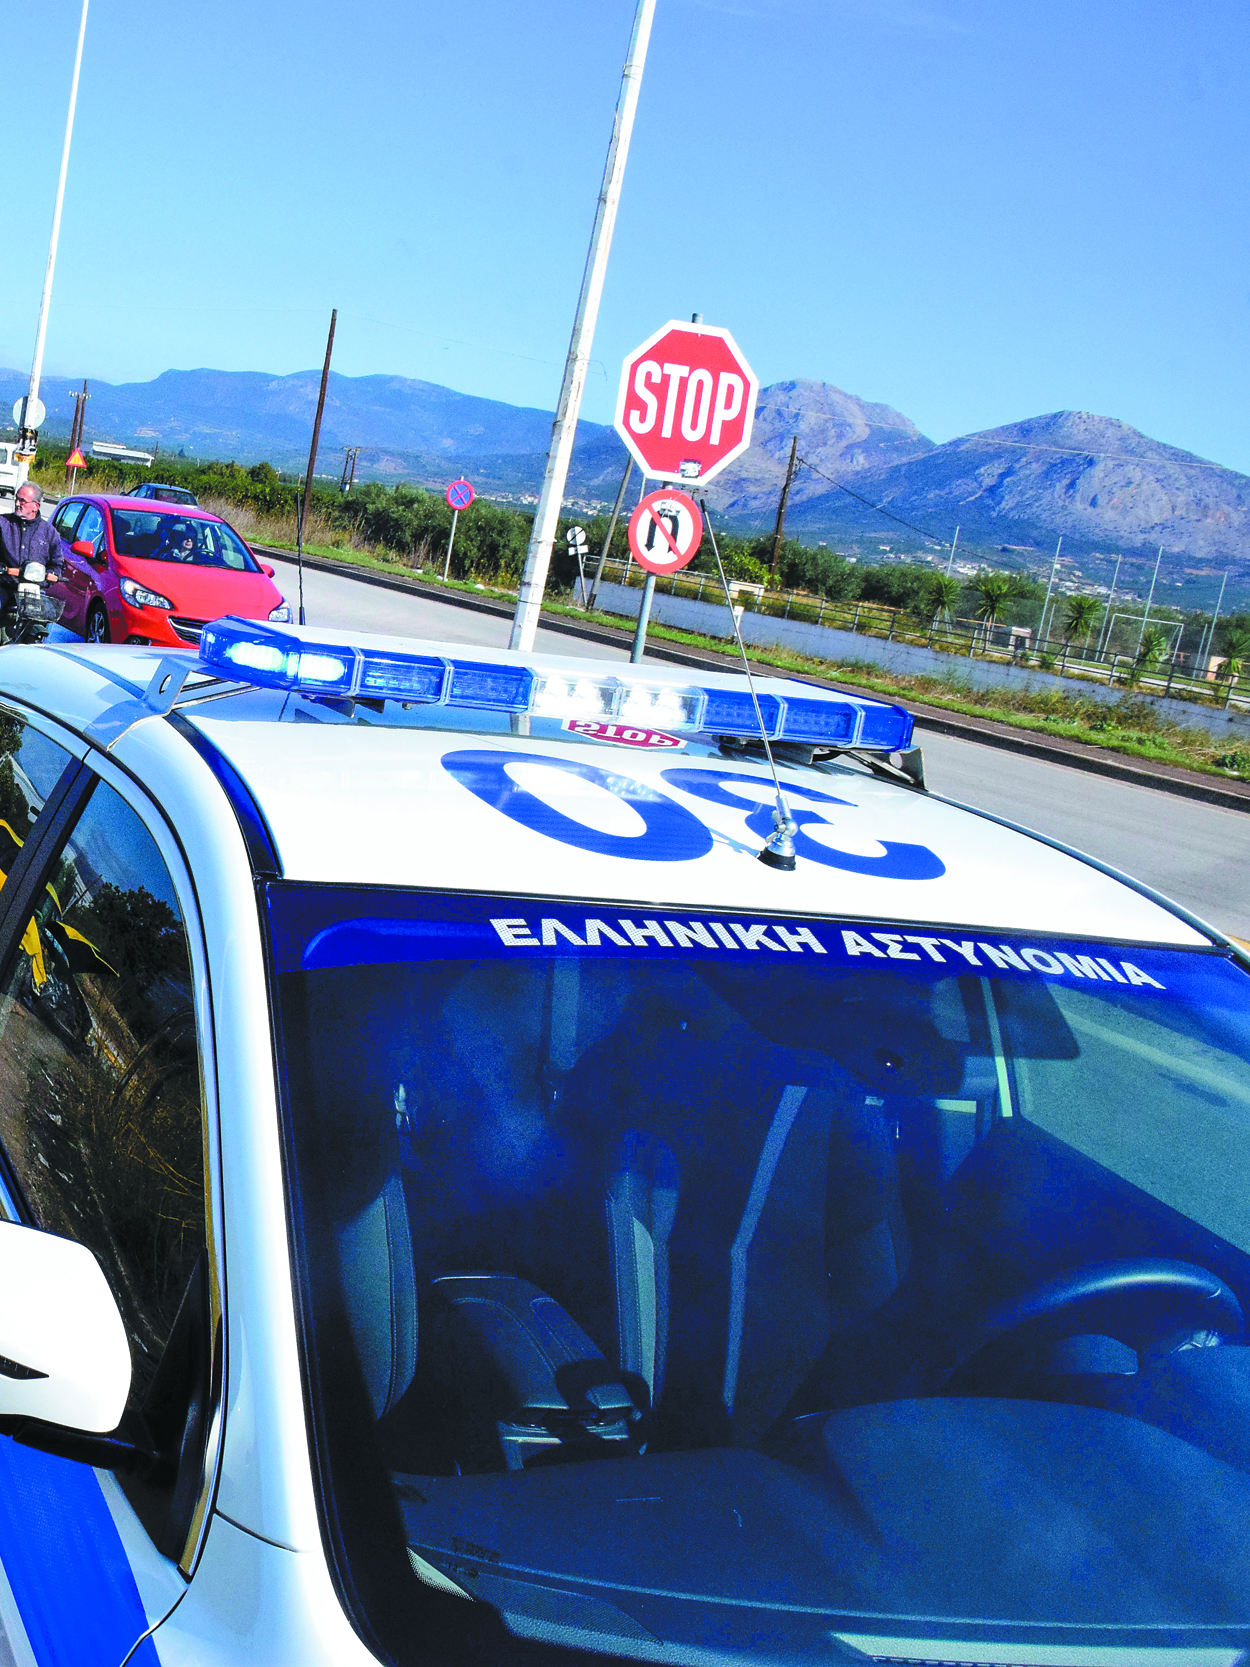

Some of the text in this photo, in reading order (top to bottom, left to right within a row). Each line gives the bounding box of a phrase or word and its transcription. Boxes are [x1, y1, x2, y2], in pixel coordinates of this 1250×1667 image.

[629, 360, 744, 446] STOP
[489, 918, 1167, 990] ΕΛΛΗΝΙΚΗ ΑΣΤΥΝΟΜΙΑ
